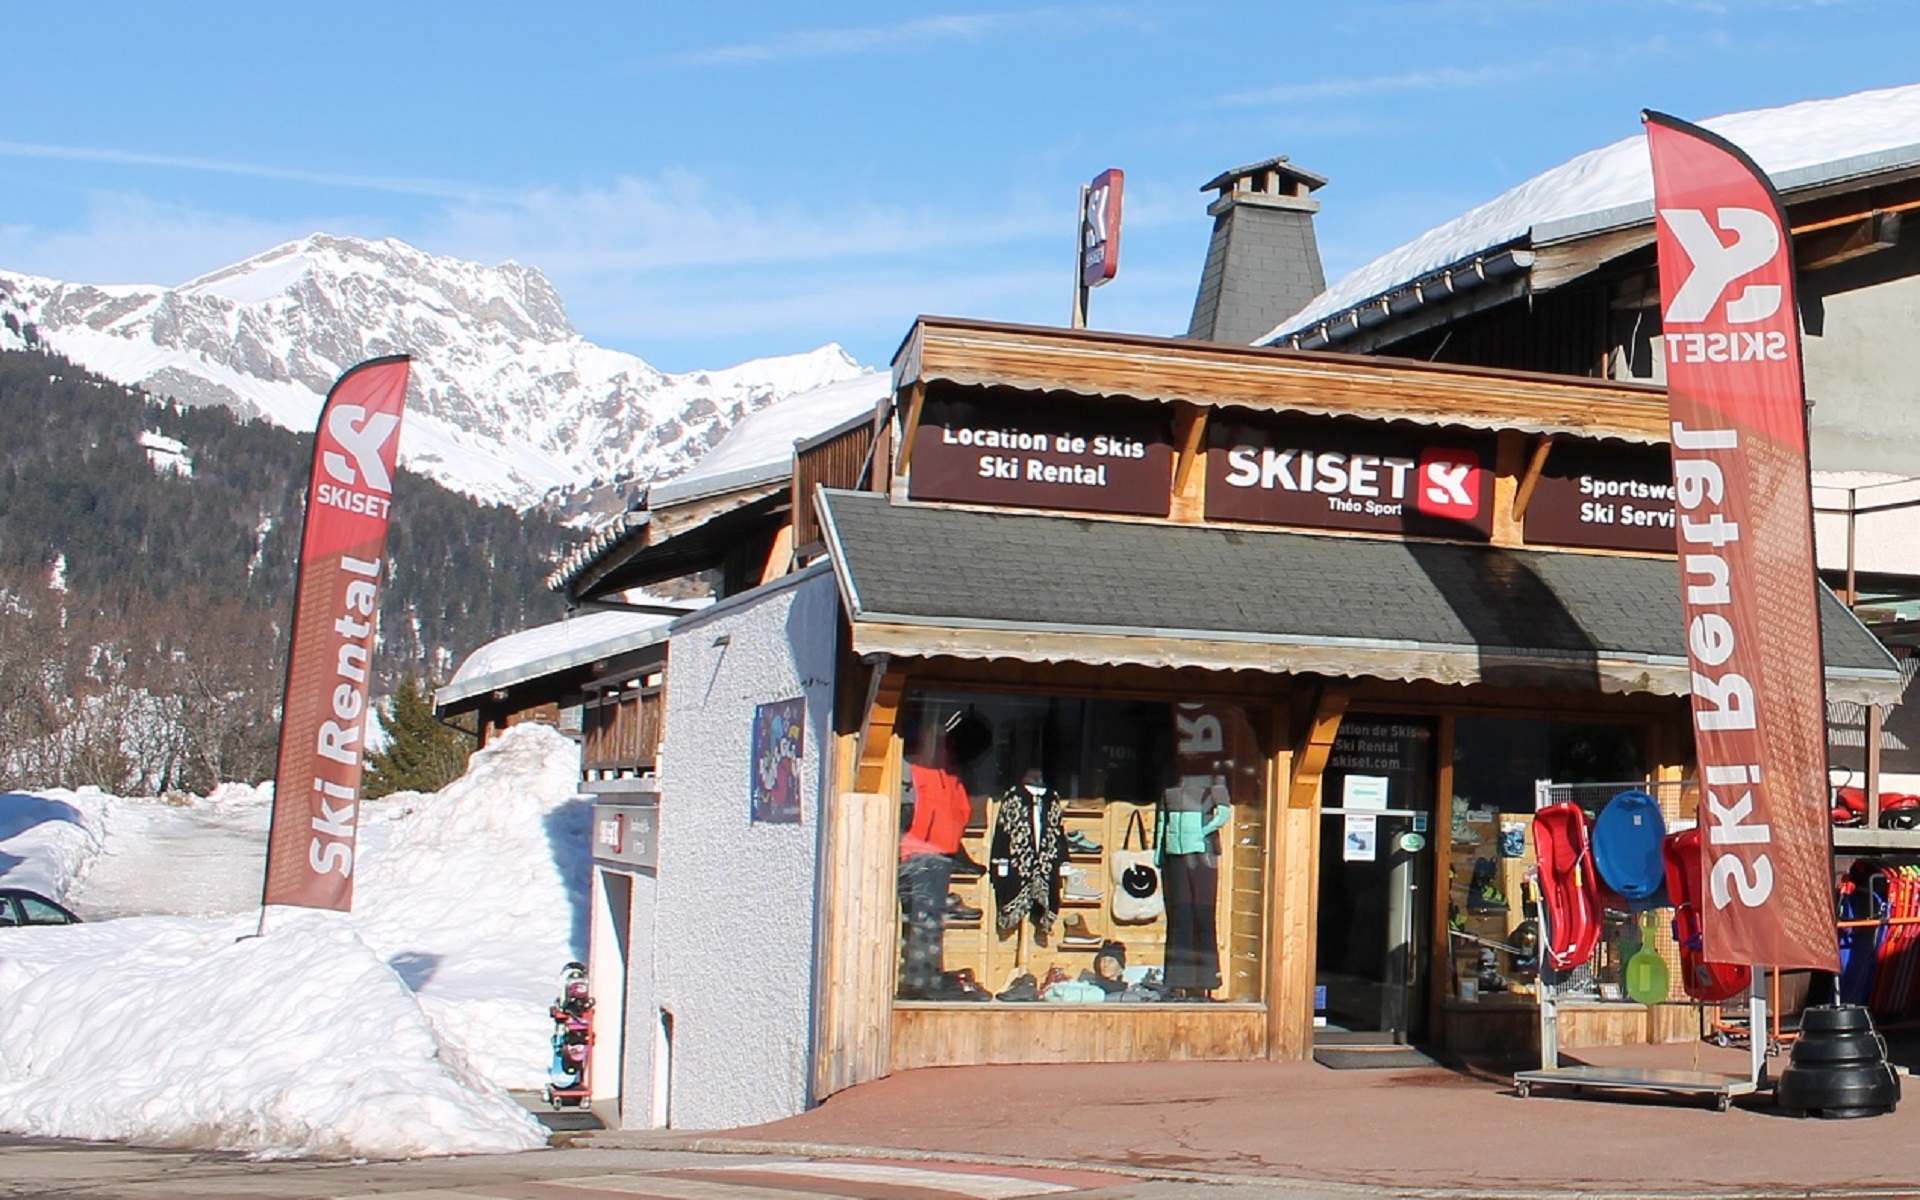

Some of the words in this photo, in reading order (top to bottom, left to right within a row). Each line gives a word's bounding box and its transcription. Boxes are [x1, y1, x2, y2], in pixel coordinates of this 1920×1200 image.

[943, 424, 1048, 451] Location
[1055, 432, 1087, 453] de
[1093, 435, 1145, 459] Skis
[978, 456, 1019, 479] Ski
[1026, 459, 1106, 486] Rental
[1225, 444, 1415, 499] SKISET
[316, 483, 392, 520] SKISET
[1580, 475, 1675, 500] Sportswe
[1328, 496, 1362, 513] Théo
[1365, 499, 1402, 516] Sport
[1581, 502, 1615, 523] Ski
[1621, 505, 1675, 528] Servi
[317, 555, 382, 766] Rental
[1335, 739, 1355, 751] Ski
[1357, 740, 1399, 753] Rental
[309, 777, 356, 879] Ski
